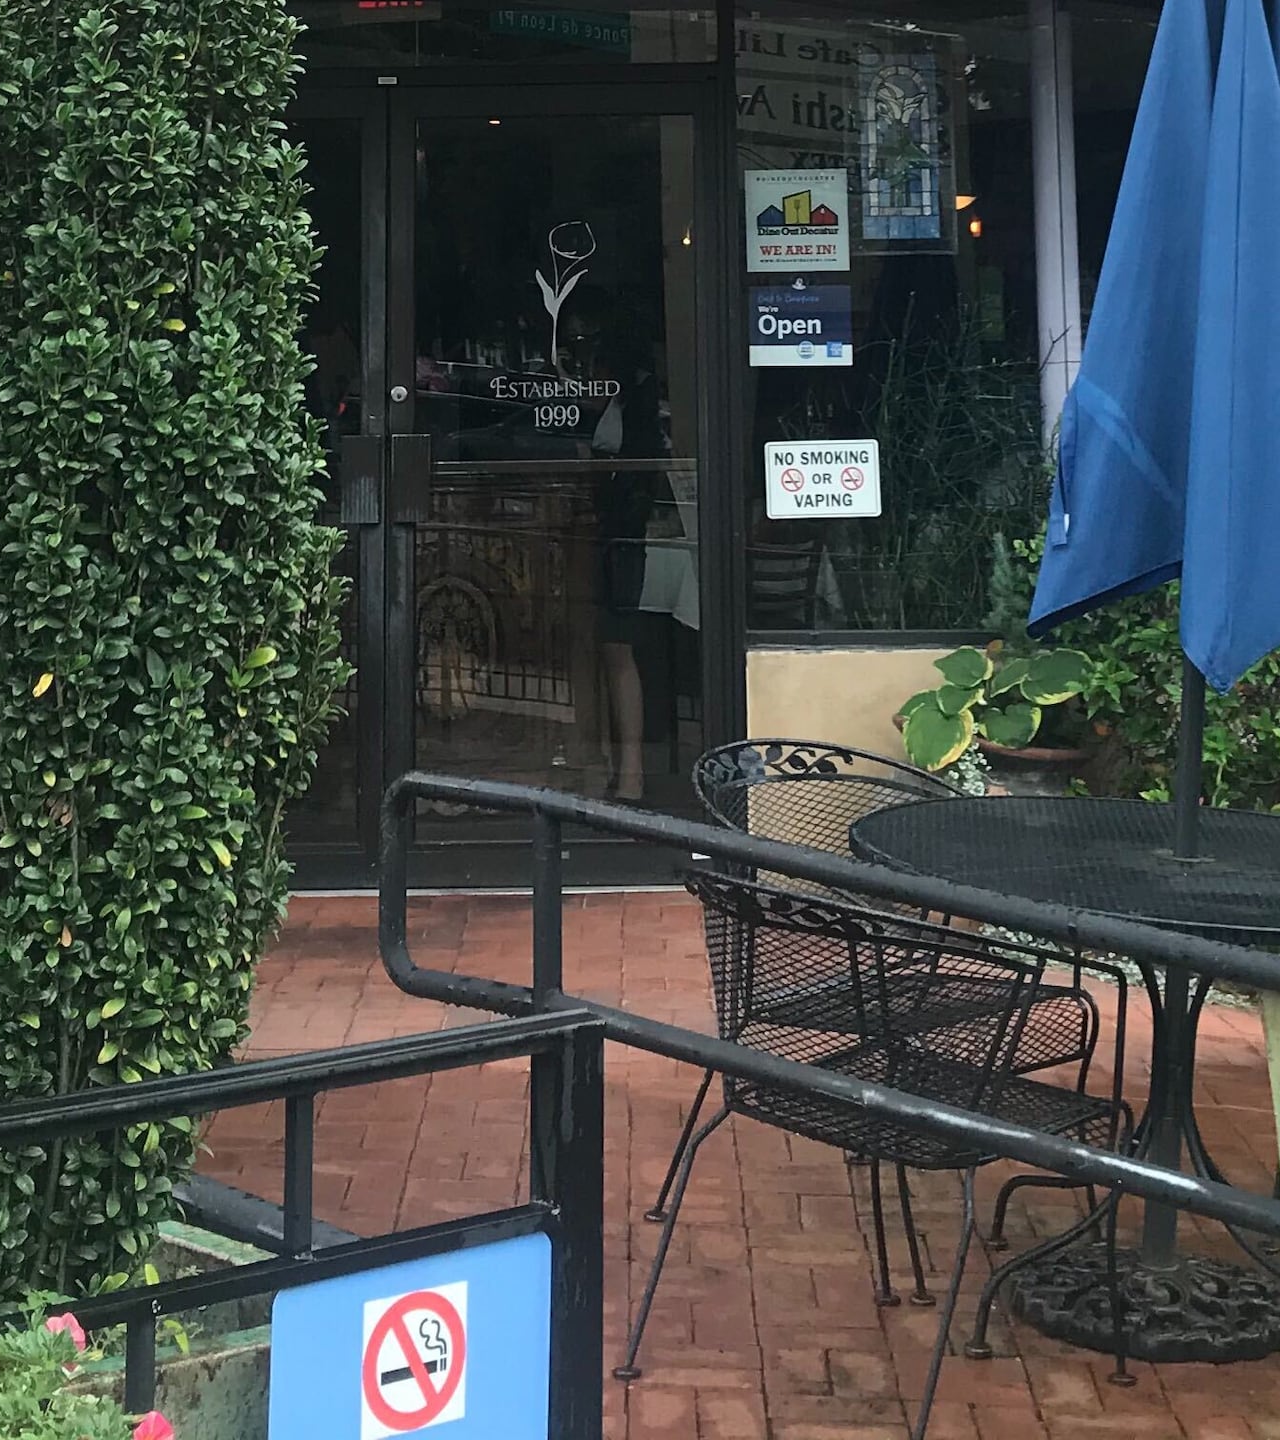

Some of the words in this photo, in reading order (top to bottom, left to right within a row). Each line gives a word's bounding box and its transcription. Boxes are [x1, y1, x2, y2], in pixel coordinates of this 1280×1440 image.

[781, 227, 800, 236] Out
[759, 245, 782, 256] WE
[785, 244, 813, 255] ARE
[815, 244, 837, 255] IN!
[758, 314, 822, 340] Open
[533, 404, 580, 428] 1999
[774, 452, 794, 466] NO
[800, 450, 869, 466] SMOKING
[811, 473, 832, 485] OR
[794, 493, 853, 508] VAPING
